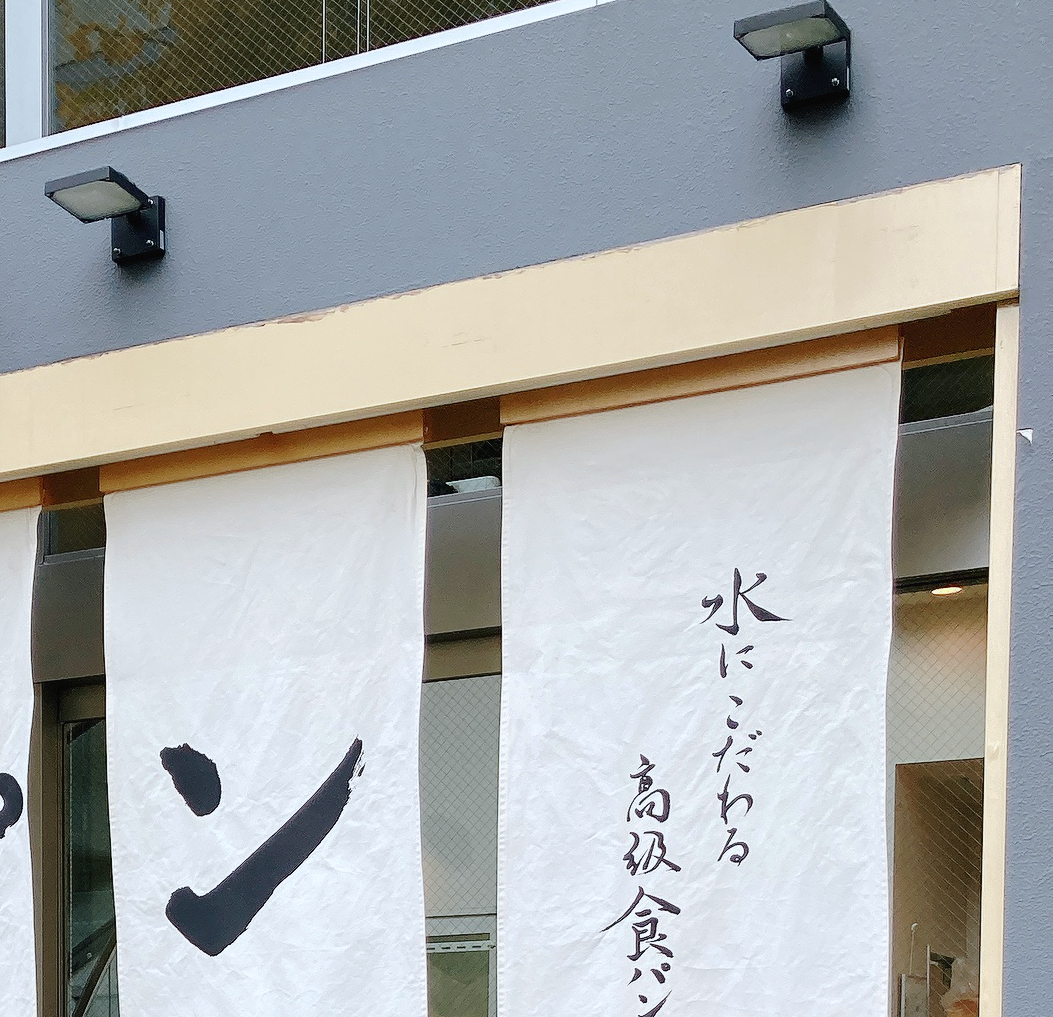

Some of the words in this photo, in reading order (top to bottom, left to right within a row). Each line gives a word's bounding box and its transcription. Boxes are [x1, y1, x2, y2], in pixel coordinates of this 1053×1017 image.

[701, 567, 792, 867] 水にこだわる
